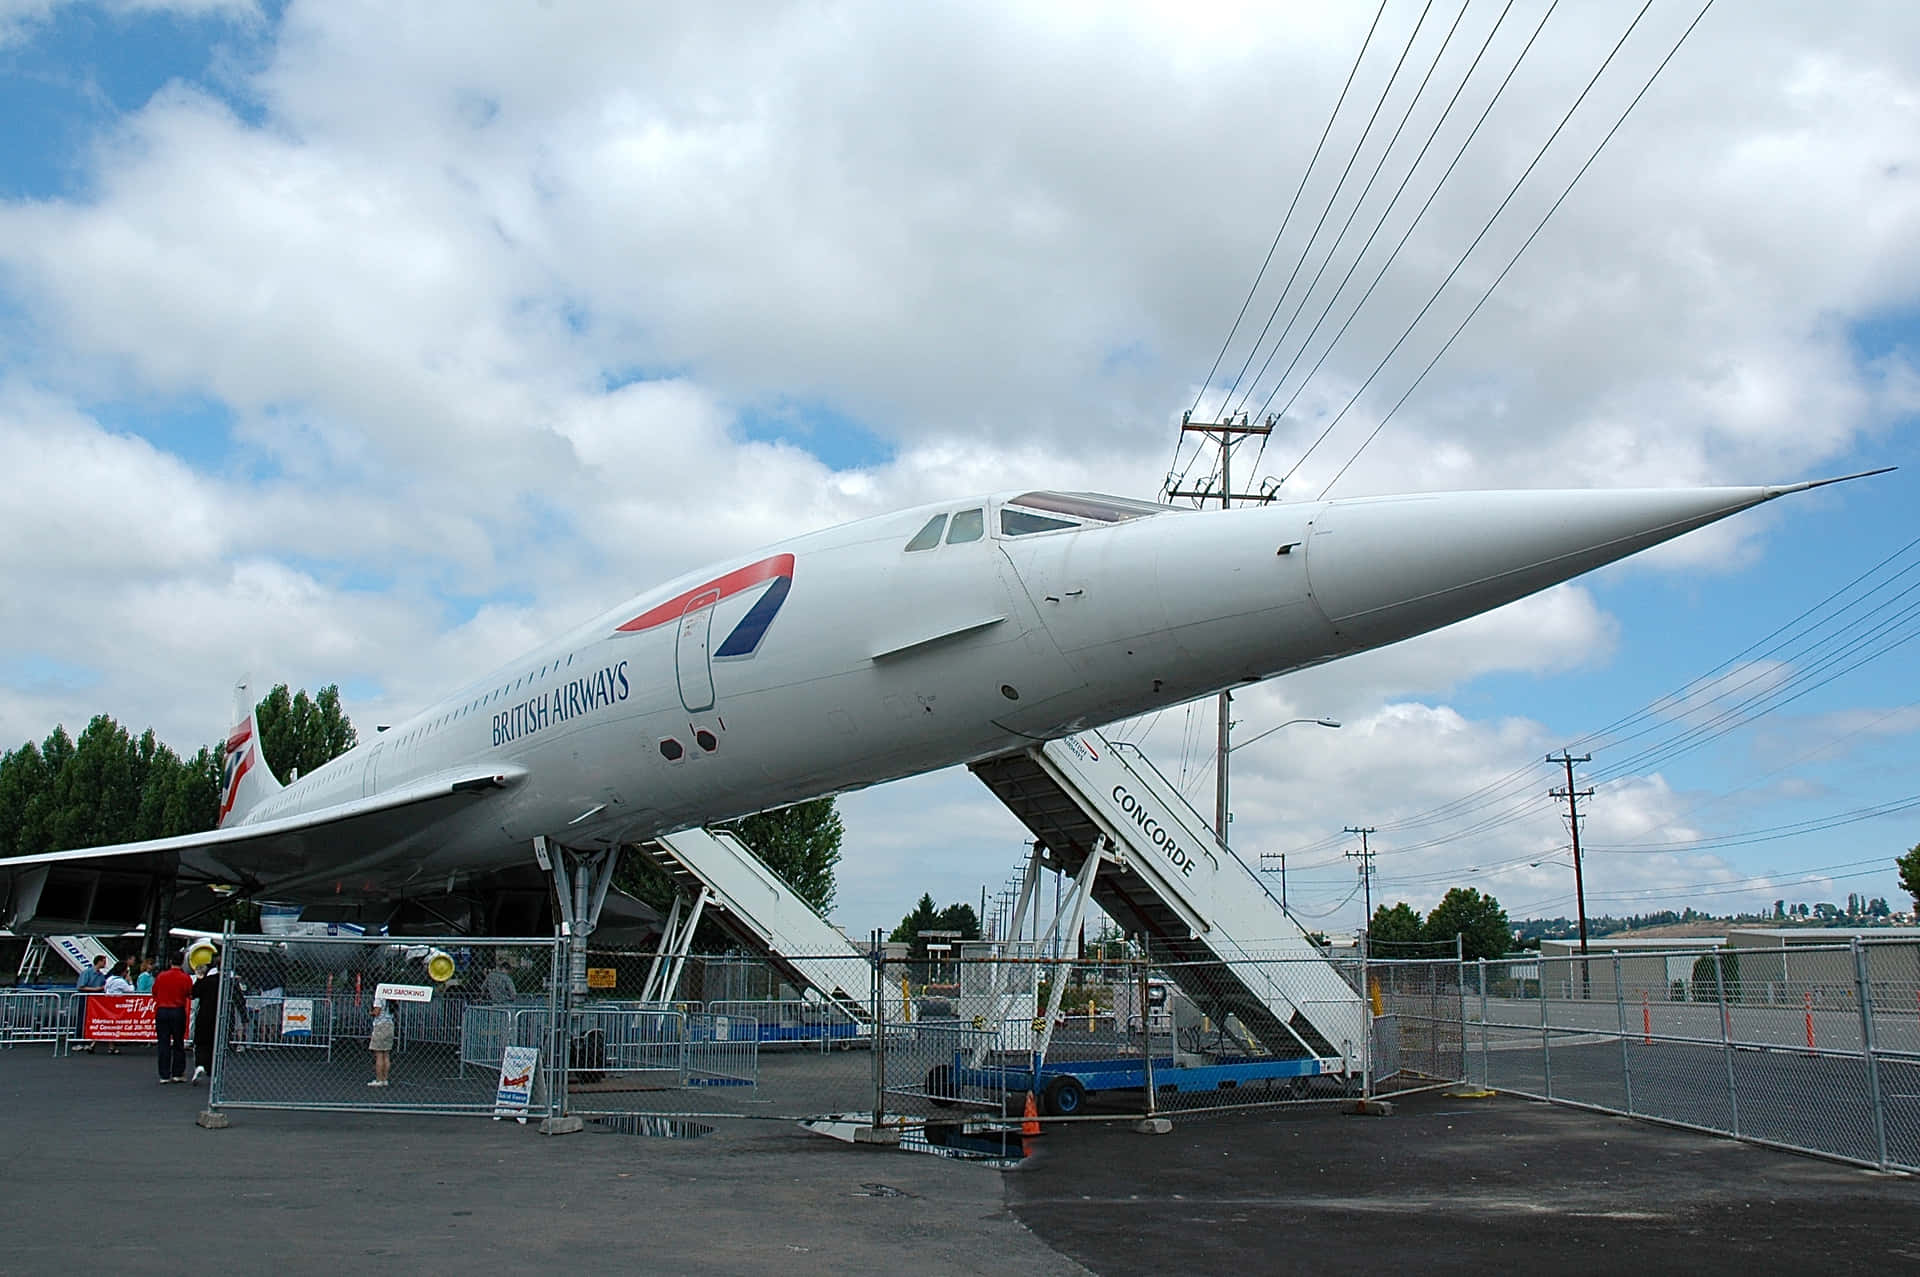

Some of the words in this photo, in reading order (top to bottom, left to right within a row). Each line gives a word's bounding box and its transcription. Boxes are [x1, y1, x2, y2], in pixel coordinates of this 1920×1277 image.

[491, 692, 549, 747] BRITISH
[551, 660, 630, 725] AIRWAYS
[1112, 785, 1196, 878] CONCORDE
[134, 998, 157, 1018] Flight
[394, 989, 425, 997] SMOKING
